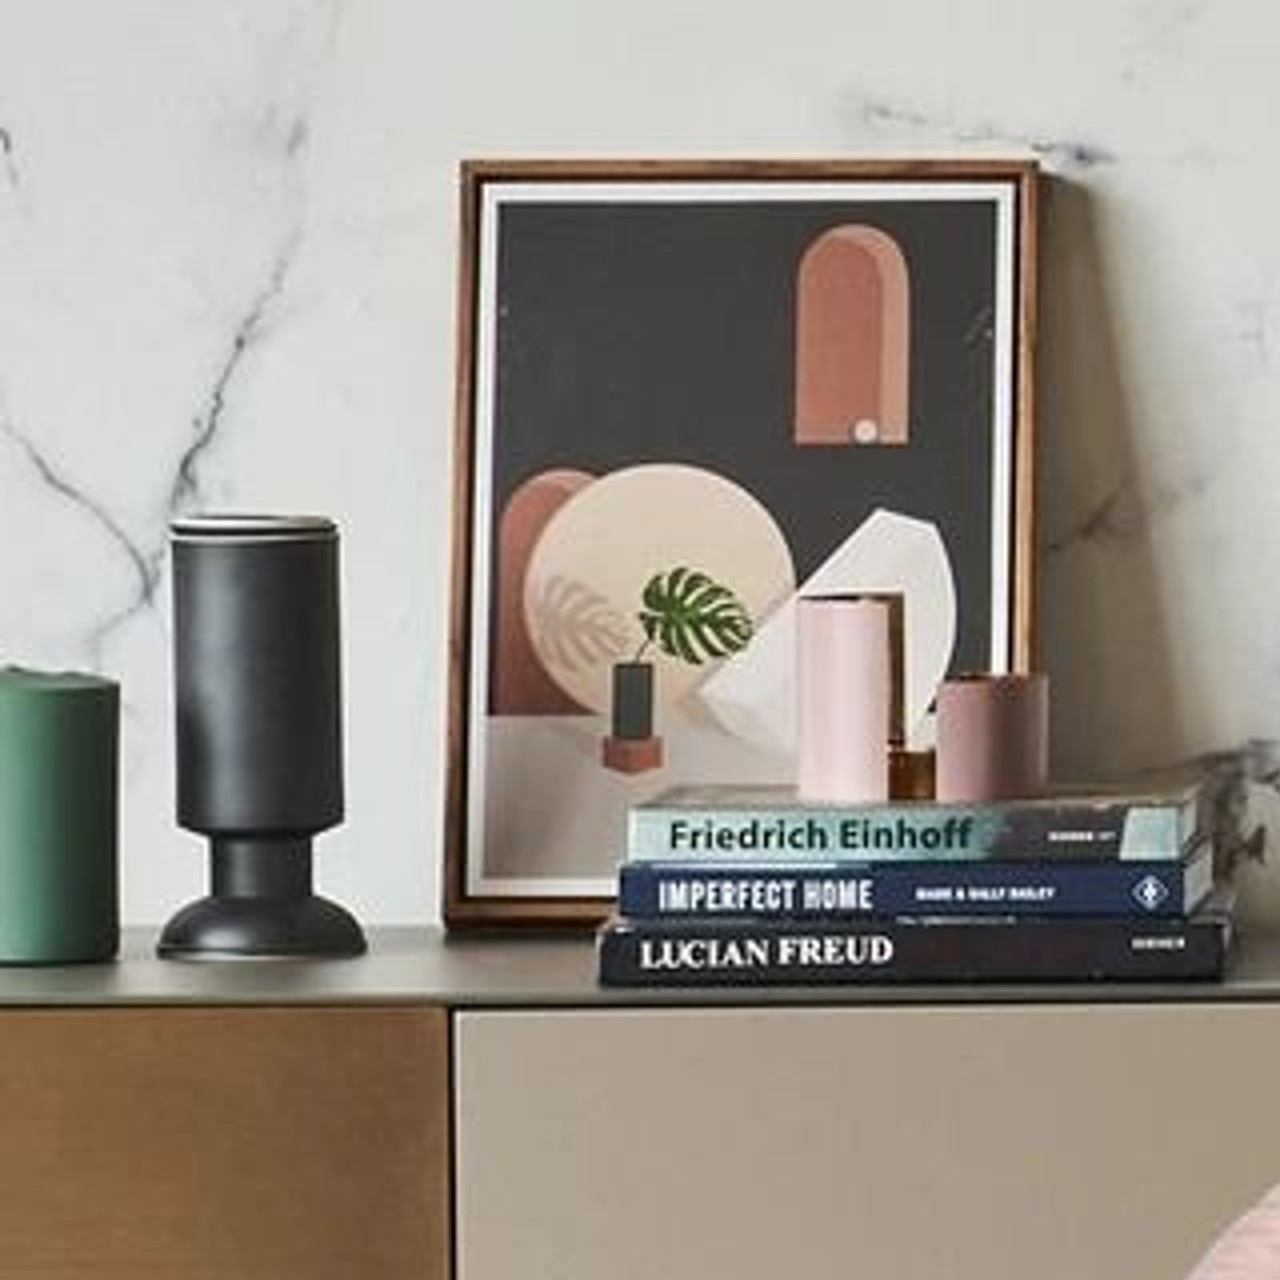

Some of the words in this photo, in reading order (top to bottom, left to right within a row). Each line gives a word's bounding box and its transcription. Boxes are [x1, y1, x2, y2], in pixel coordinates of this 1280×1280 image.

[670, 818, 828, 851] Friedrich
[840, 817, 974, 850] Einhoff
[659, 880, 797, 911] IMPERFECT
[803, 879, 874, 910] HOME
[640, 937, 770, 969] LUCIAN
[778, 934, 894, 966] FREUD
